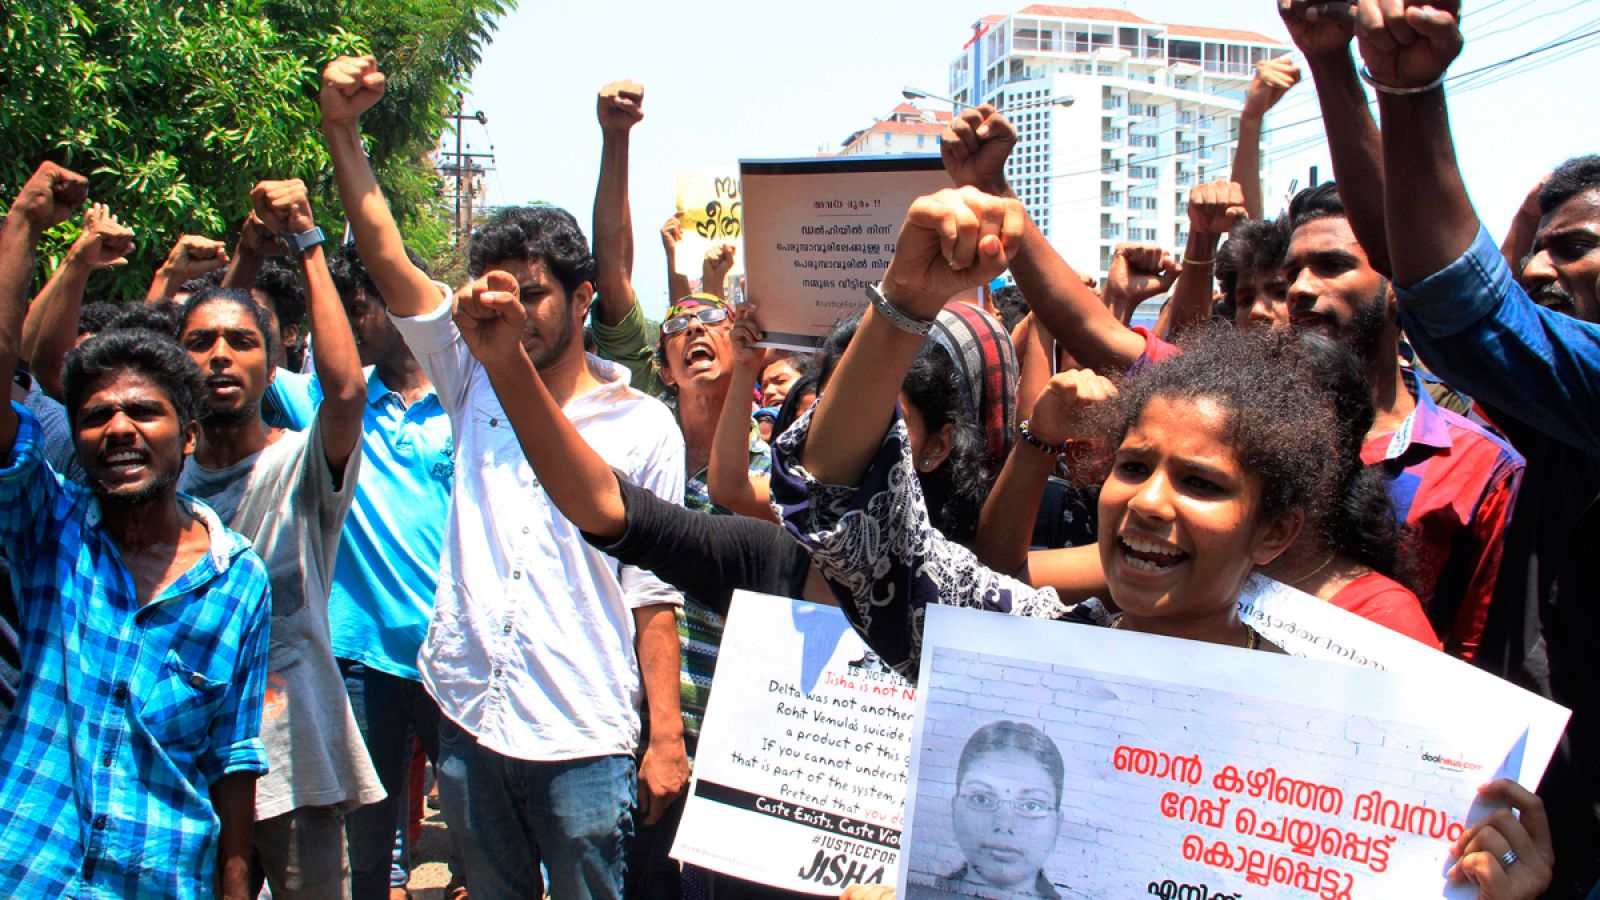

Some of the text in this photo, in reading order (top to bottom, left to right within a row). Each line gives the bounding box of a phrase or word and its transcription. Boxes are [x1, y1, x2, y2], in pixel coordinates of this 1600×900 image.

[801, 223, 893, 235] ഡൽഹിയിൽ നിന്ന്
[823, 671, 855, 689] Jisha
[860, 681, 869, 692] is
[872, 685, 898, 698] not
[864, 669, 886, 682] NOT
[768, 679, 914, 721] Delta was not another
[776, 702, 808, 720] Rohit
[863, 723, 905, 741] suicide
[761, 737, 776, 752] If
[779, 745, 800, 758] you
[804, 752, 852, 770] cannot
[786, 728, 793, 737] a
[796, 730, 852, 750] product
[854, 742, 874, 753] of
[876, 743, 900, 762] this
[731, 751, 758, 767] that
[761, 759, 770, 771] is
[772, 766, 804, 779] part
[807, 772, 825, 783] of
[827, 776, 849, 791] the
[852, 785, 896, 805] system,
[1113, 745, 1466, 843] ഞാൻ കഴിഞ്ഞ ദിവസം
[755, 796, 790, 817] Caste
[793, 806, 834, 829] Exists.
[838, 818, 875, 840] Caste
[779, 783, 829, 806] Pretend
[832, 798, 861, 813] that
[864, 807, 886, 821] you
[811, 834, 897, 865] #JUSTICEFOR
[1160, 791, 1397, 873] റേപ്പ് ചെയ്യപ്പെട്ട്
[798, 849, 885, 889] JISHA
[1182, 834, 1354, 900] കൊല്ലപ്പെട്ടു
